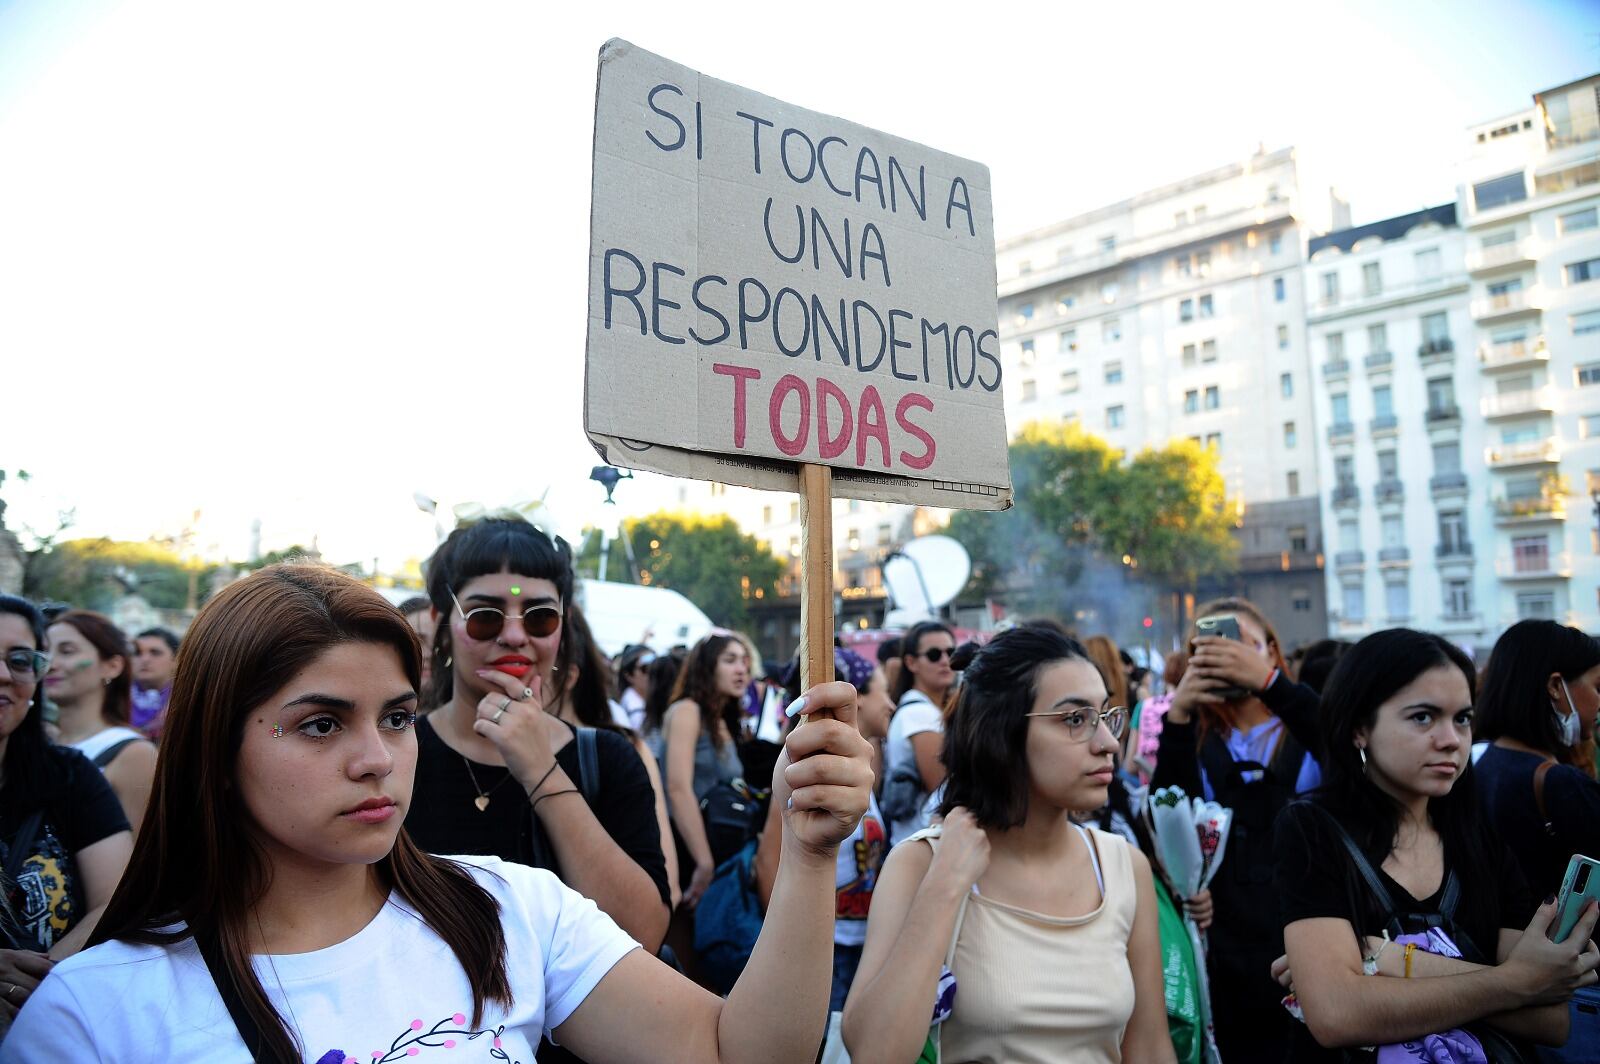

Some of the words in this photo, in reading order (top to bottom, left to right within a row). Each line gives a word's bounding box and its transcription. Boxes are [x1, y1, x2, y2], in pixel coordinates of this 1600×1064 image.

[645, 84, 702, 160] SI
[736, 111, 926, 221] TOCAN
[946, 176, 976, 236] A
[763, 197, 892, 287] UNA
[603, 248, 1003, 392] RESPONDEMOS
[713, 363, 936, 469] TODAS
